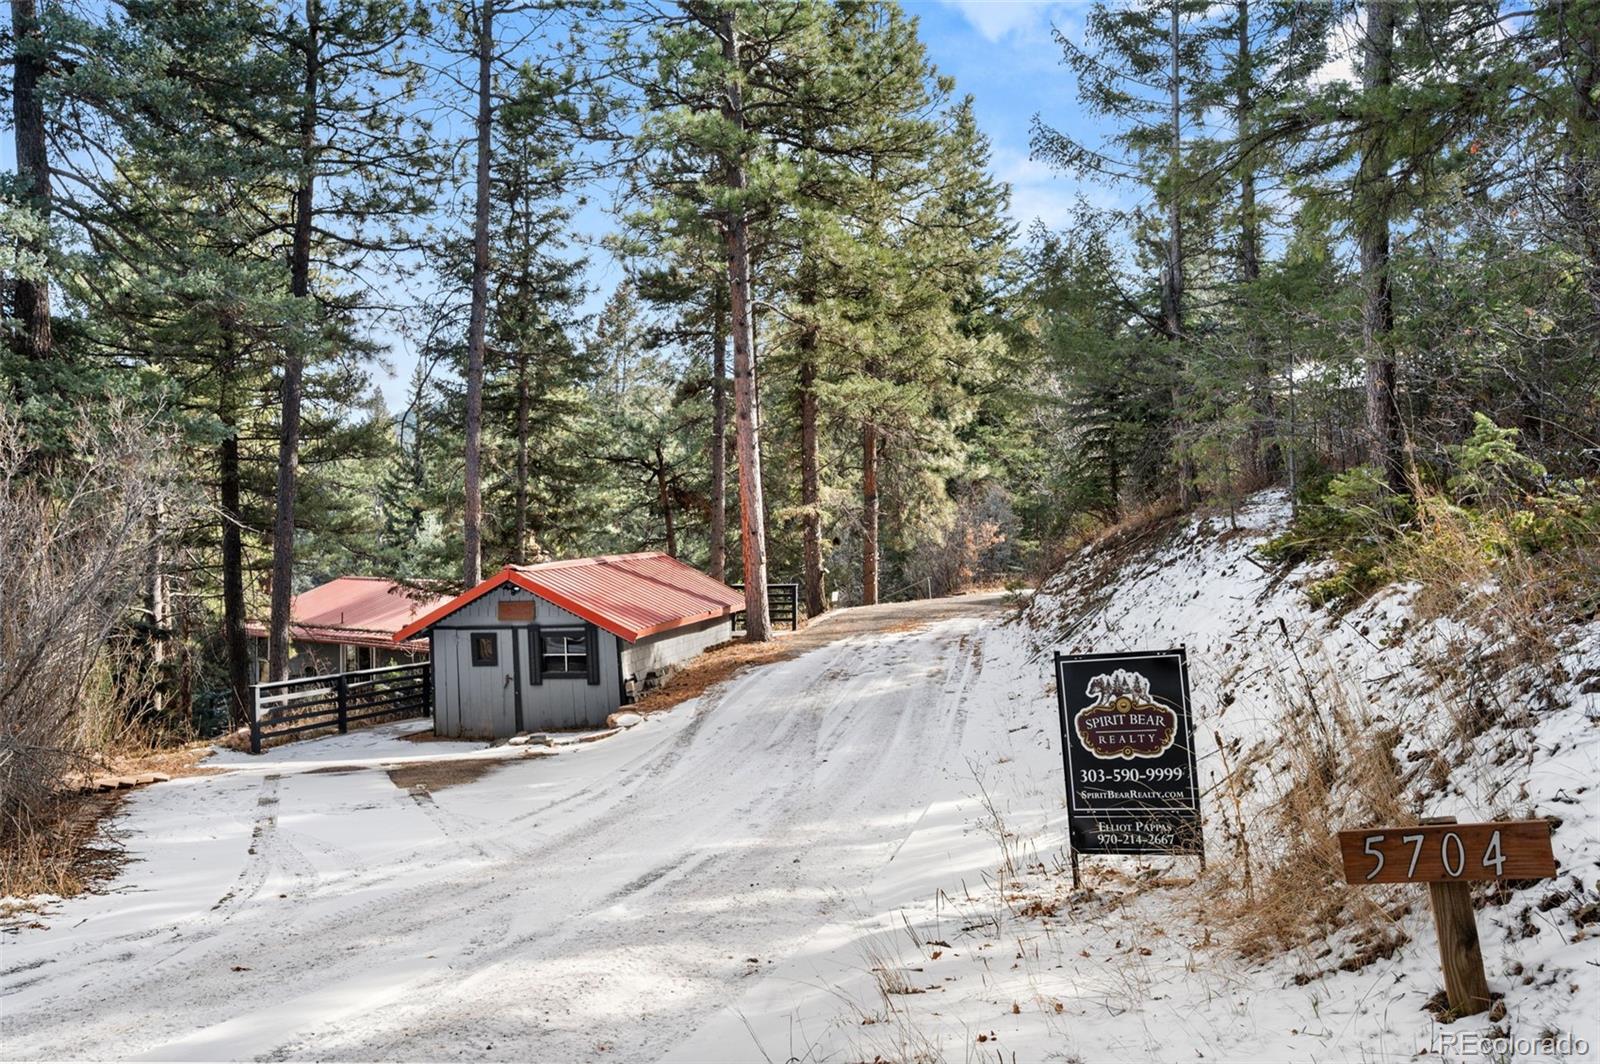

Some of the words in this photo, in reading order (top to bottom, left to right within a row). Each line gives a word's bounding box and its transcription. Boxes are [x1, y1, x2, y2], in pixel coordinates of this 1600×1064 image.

[1085, 714, 1126, 730] SPIRIT
[1129, 713, 1166, 727] BEAR
[1098, 733, 1156, 744] REALTY
[1080, 767, 1183, 783] 303-590-9999
[1097, 834, 1175, 845] 970-214-2667
[1364, 830, 1507, 880] 5704
